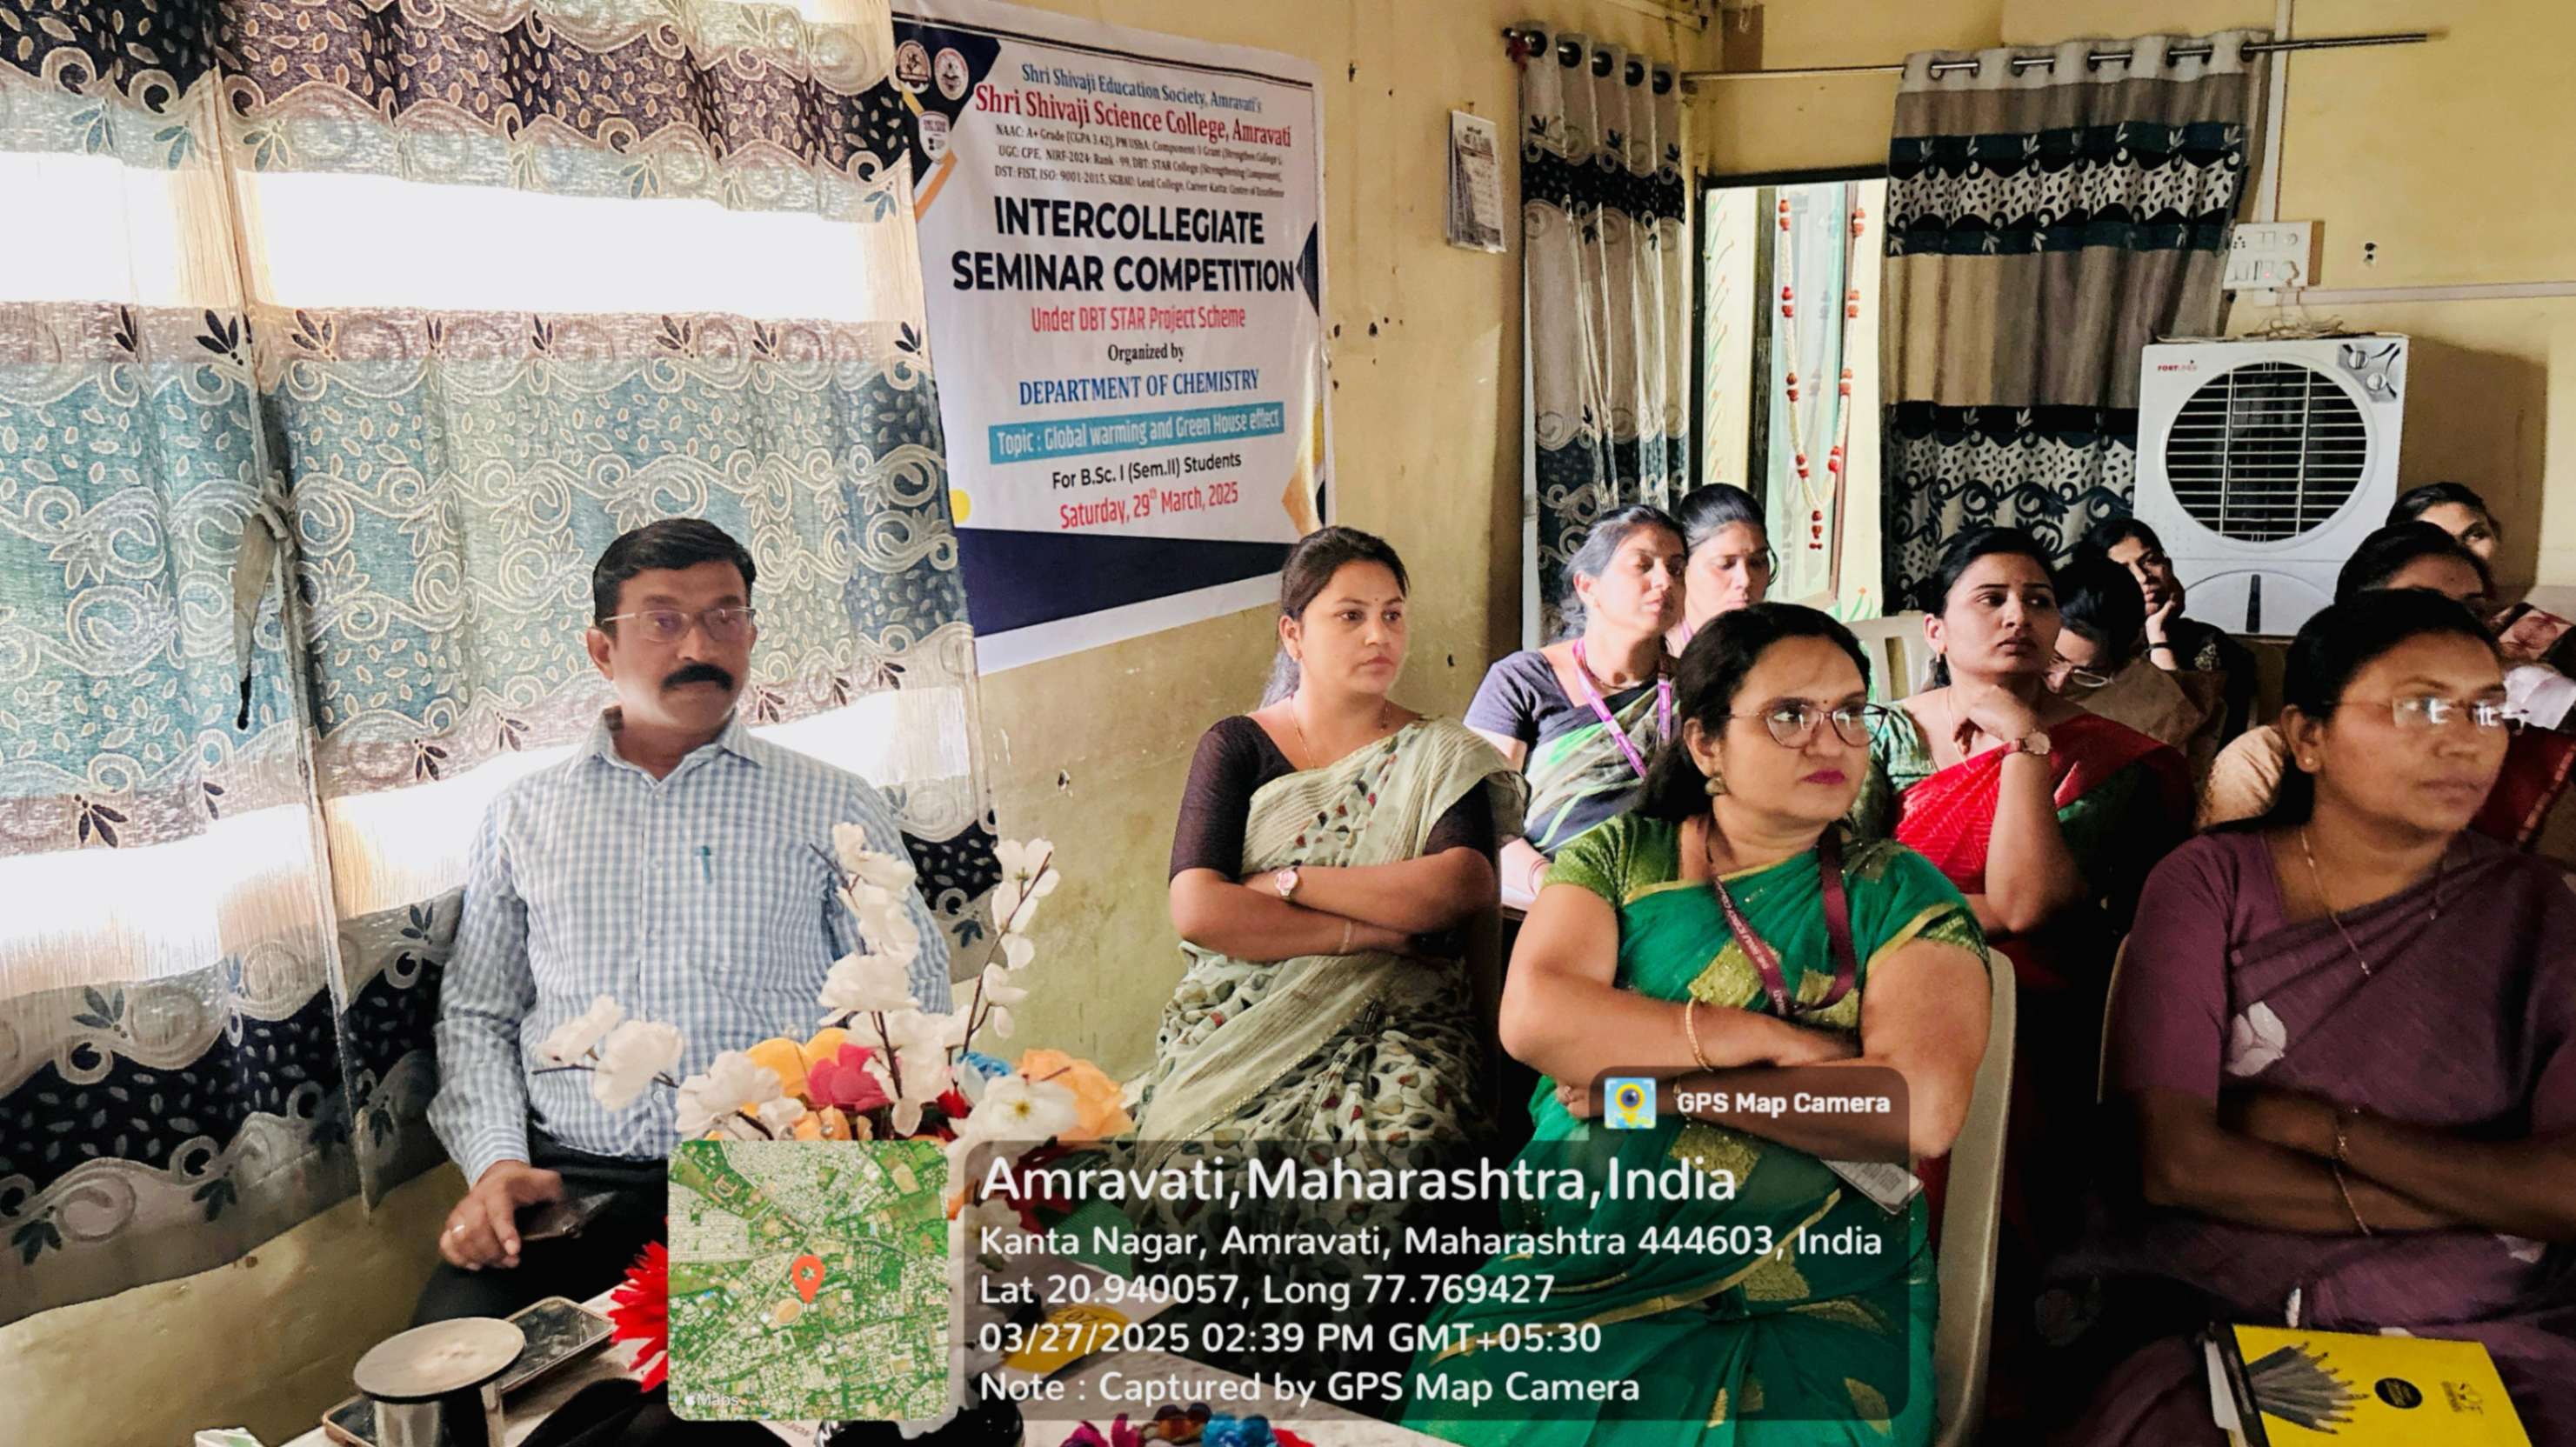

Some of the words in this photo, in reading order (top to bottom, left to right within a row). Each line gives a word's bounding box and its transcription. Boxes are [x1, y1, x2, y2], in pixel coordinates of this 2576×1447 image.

[1022, 64, 1050, 83] Shri
[1053, 69, 1096, 94] Shivaji
[1098, 75, 1160, 100] Education
[1162, 84, 1208, 109] Society,
[975, 84, 1021, 115] Shri
[1026, 90, 1090, 129] Shivaji
[1093, 100, 1162, 131] Science
[1166, 110, 1229, 143] College,
[1232, 118, 1291, 147] Amravati
[1026, 127, 1038, 139] A+
[1040, 130, 1064, 143] Grade
[1152, 158, 1171, 171] STAR
[994, 195, 1265, 244] INTERCOLLEGIATE
[951, 250, 1104, 291] SEMINAR
[1114, 256, 1296, 293] COMPETITION
[1031, 306, 1075, 332] Under
[1079, 306, 1107, 331] DBT
[1110, 306, 1146, 330] STAR
[1149, 306, 1196, 333] Project
[1198, 305, 1246, 329] Scheme
[1107, 344, 1168, 364] Organized
[1171, 343, 1185, 363] by
[1019, 376, 1141, 406] DEPARTMENT
[1146, 374, 1169, 397] OF
[1173, 369, 1260, 396] CHEMISTRY
[997, 430, 1034, 457] Topic
[1044, 426, 1086, 450] Global
[1089, 420, 1148, 446] warming
[1150, 417, 1174, 439] and
[1176, 413, 1211, 436] Green
[1213, 410, 1247, 432] House
[1249, 407, 1281, 430] effect
[1052, 471, 1077, 489] For
[1081, 466, 1118, 487] B.Sc.
[1119, 464, 1124, 481] I
[1128, 457, 1181, 483] (Sem.II)
[1184, 452, 1242, 474] Students
[1059, 497, 1131, 529] Saturday,
[1161, 485, 1205, 514] March,
[1209, 482, 1238, 506] 2025
